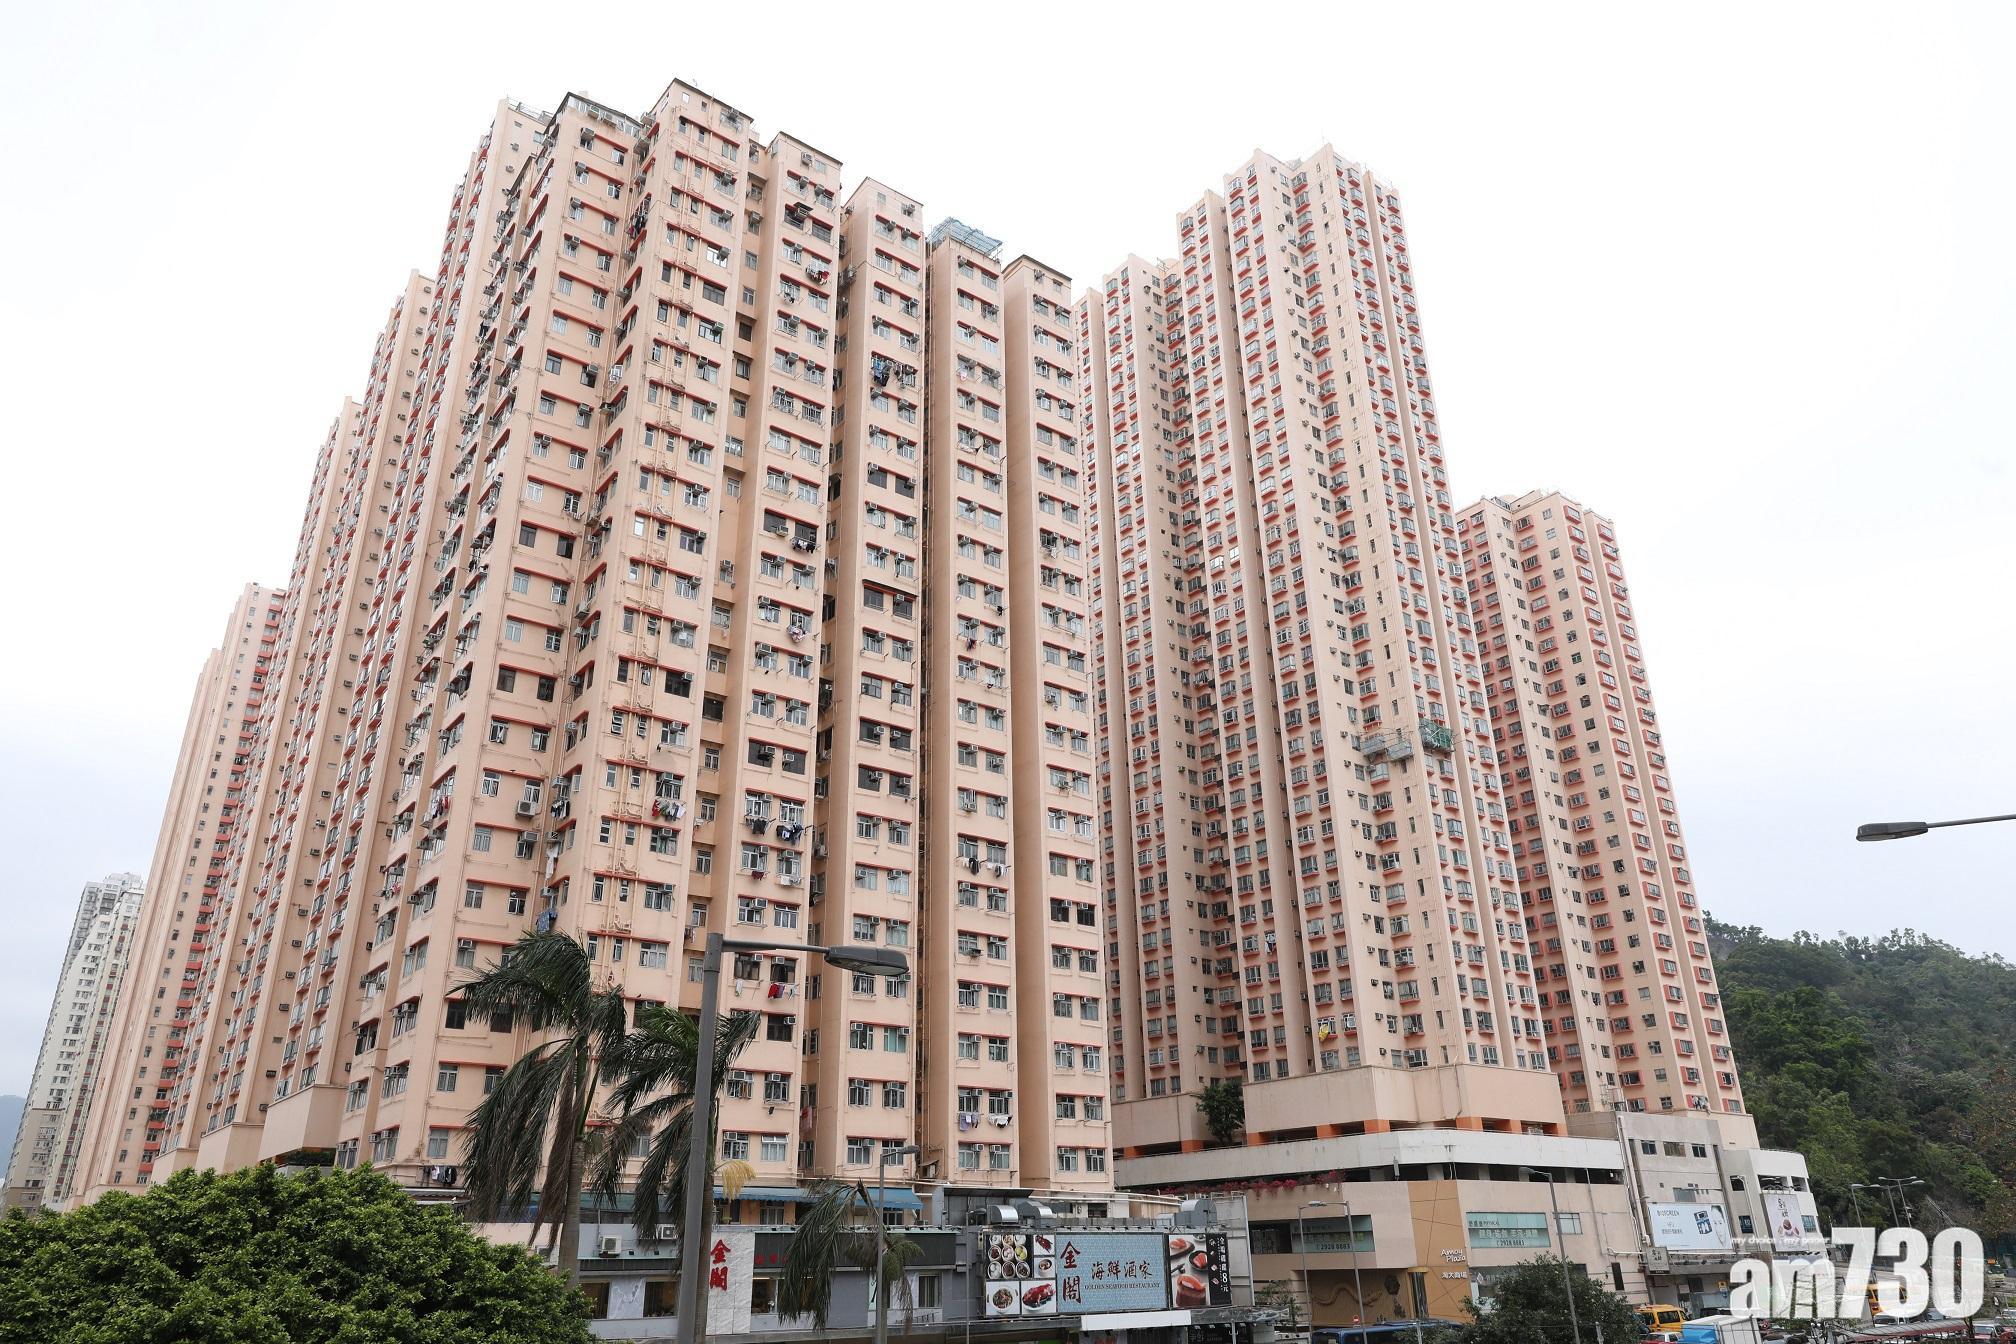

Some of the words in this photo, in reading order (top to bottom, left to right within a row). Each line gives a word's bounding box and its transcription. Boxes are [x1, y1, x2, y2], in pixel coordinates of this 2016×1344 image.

[1060, 1241, 1081, 1304] 金閣
[1091, 1260, 1152, 1280] 海鮮酒家
